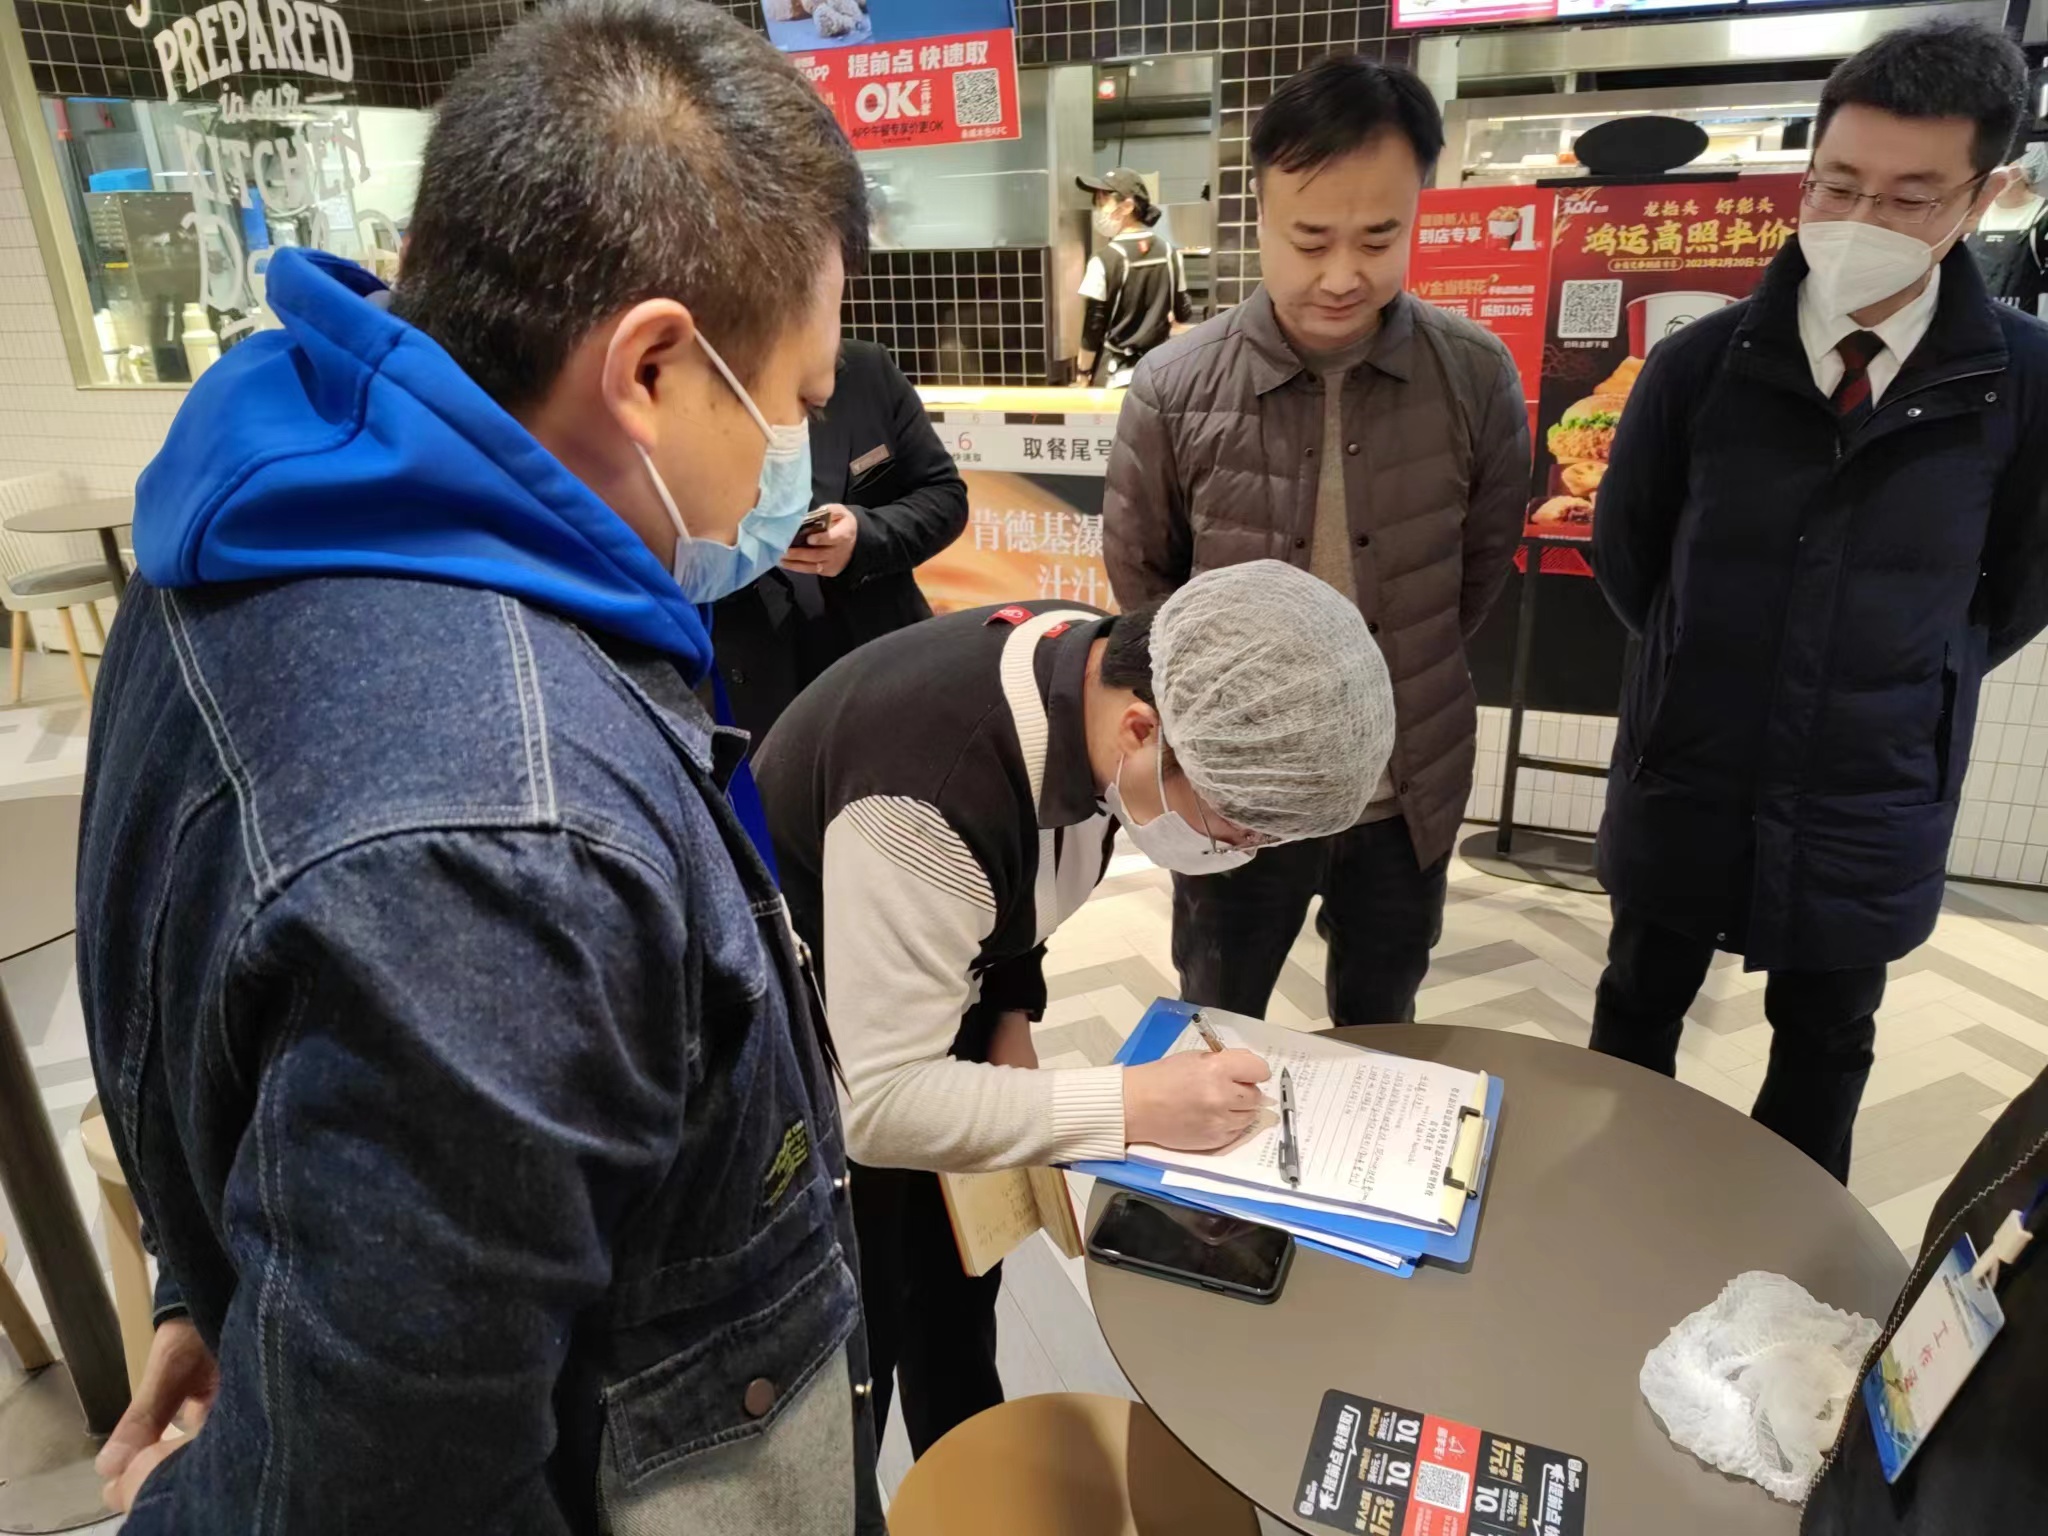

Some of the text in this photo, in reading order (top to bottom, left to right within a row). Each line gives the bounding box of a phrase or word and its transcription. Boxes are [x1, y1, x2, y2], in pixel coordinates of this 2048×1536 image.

[154, 0, 354, 106] PREPARED
[847, 40, 989, 79] 提前点 快速取
[219, 83, 301, 123] in our
[855, 79, 921, 124] OK
[175, 108, 372, 218] KITCHEN
[1643, 200, 1700, 217] 龙抬头
[1419, 227, 1483, 243] 到店专享
[1581, 217, 1796, 257] 鸿运高照半价
[1480, 303, 1534, 318] 抵扣10元
[1023, 437, 1113, 463] 取餐尾号
[1038, 563, 1117, 606] 汁汁
[1321, 1410, 1355, 1493] 提前点 快速取
[1545, 1480, 1564, 1525] 提前点
